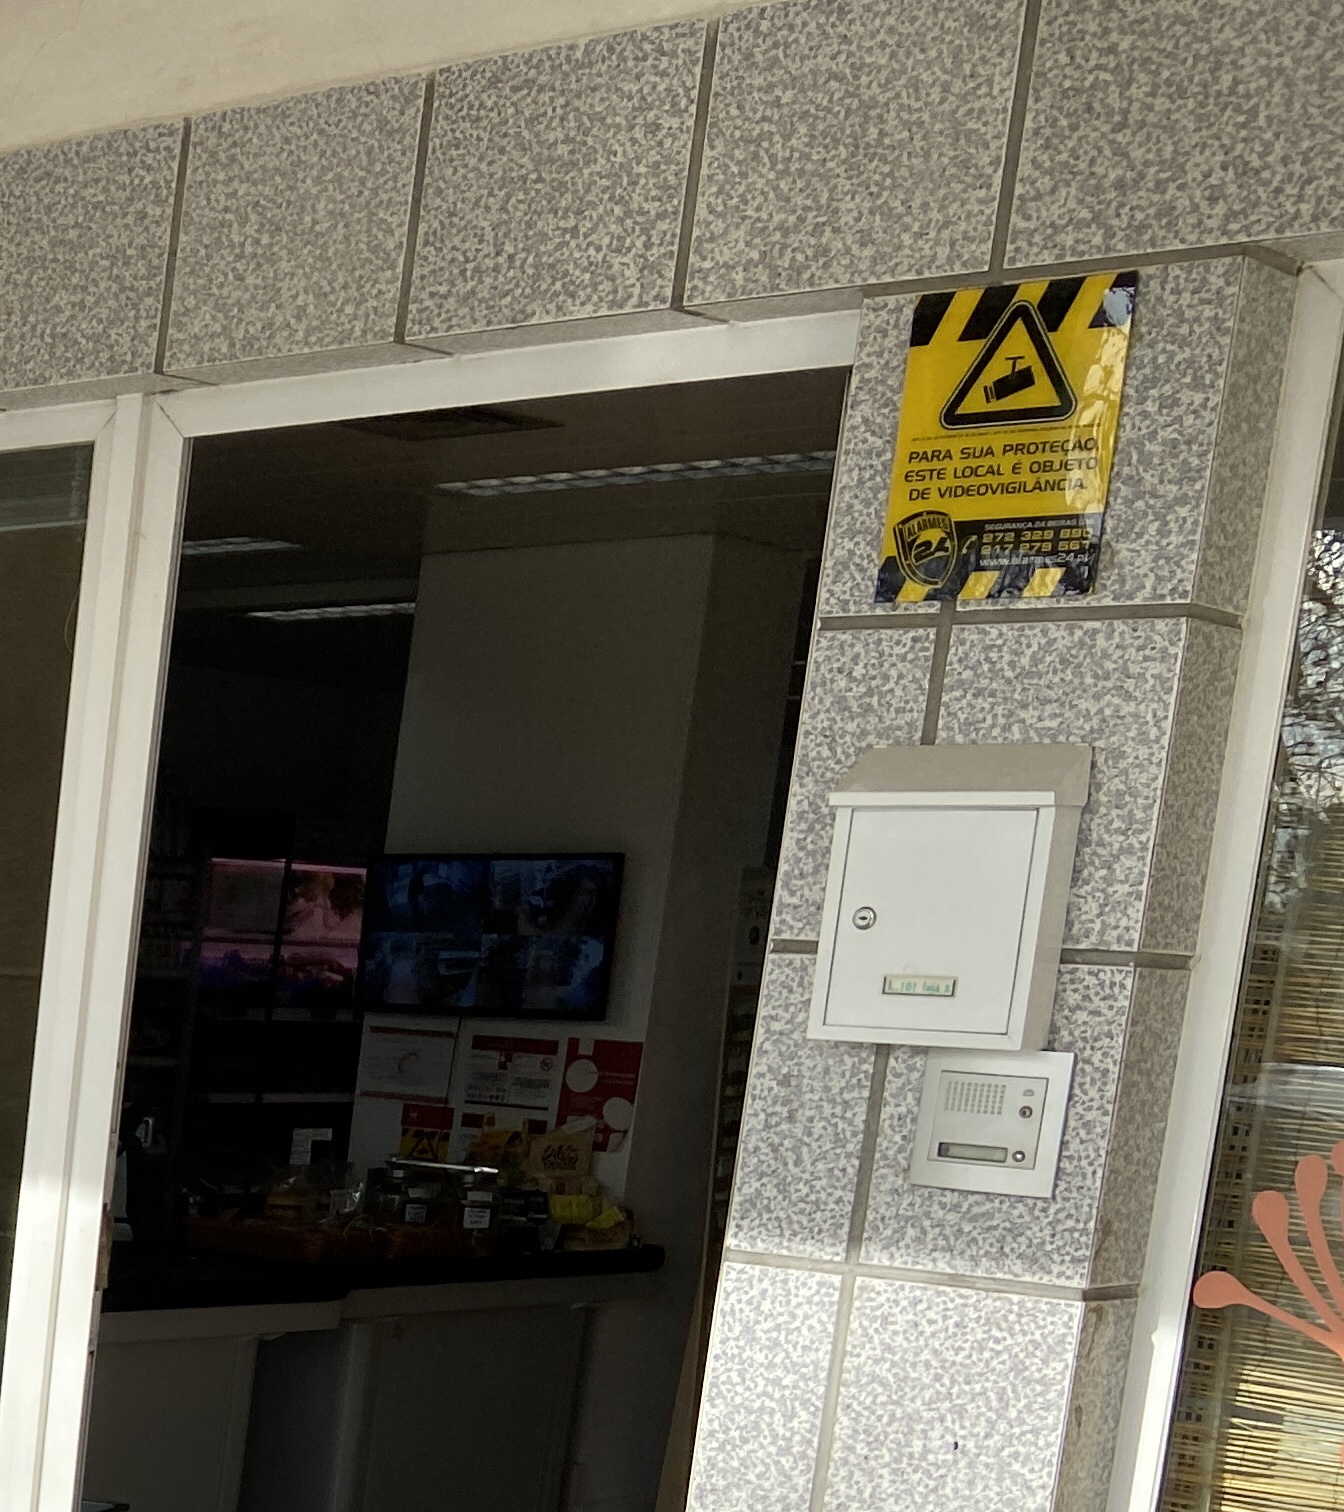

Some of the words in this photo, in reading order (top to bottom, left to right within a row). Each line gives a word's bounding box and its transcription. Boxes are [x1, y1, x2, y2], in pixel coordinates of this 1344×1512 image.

[908, 449, 953, 464] PARA
[959, 446, 995, 460] SUA
[904, 467, 947, 483] ESTE
[953, 463, 1004, 479] LOCAL
[1011, 459, 1022, 475] É
[1029, 457, 1099, 474] OBJETO
[908, 487, 931, 501] DE
[904, 516, 951, 541] ALARMES
